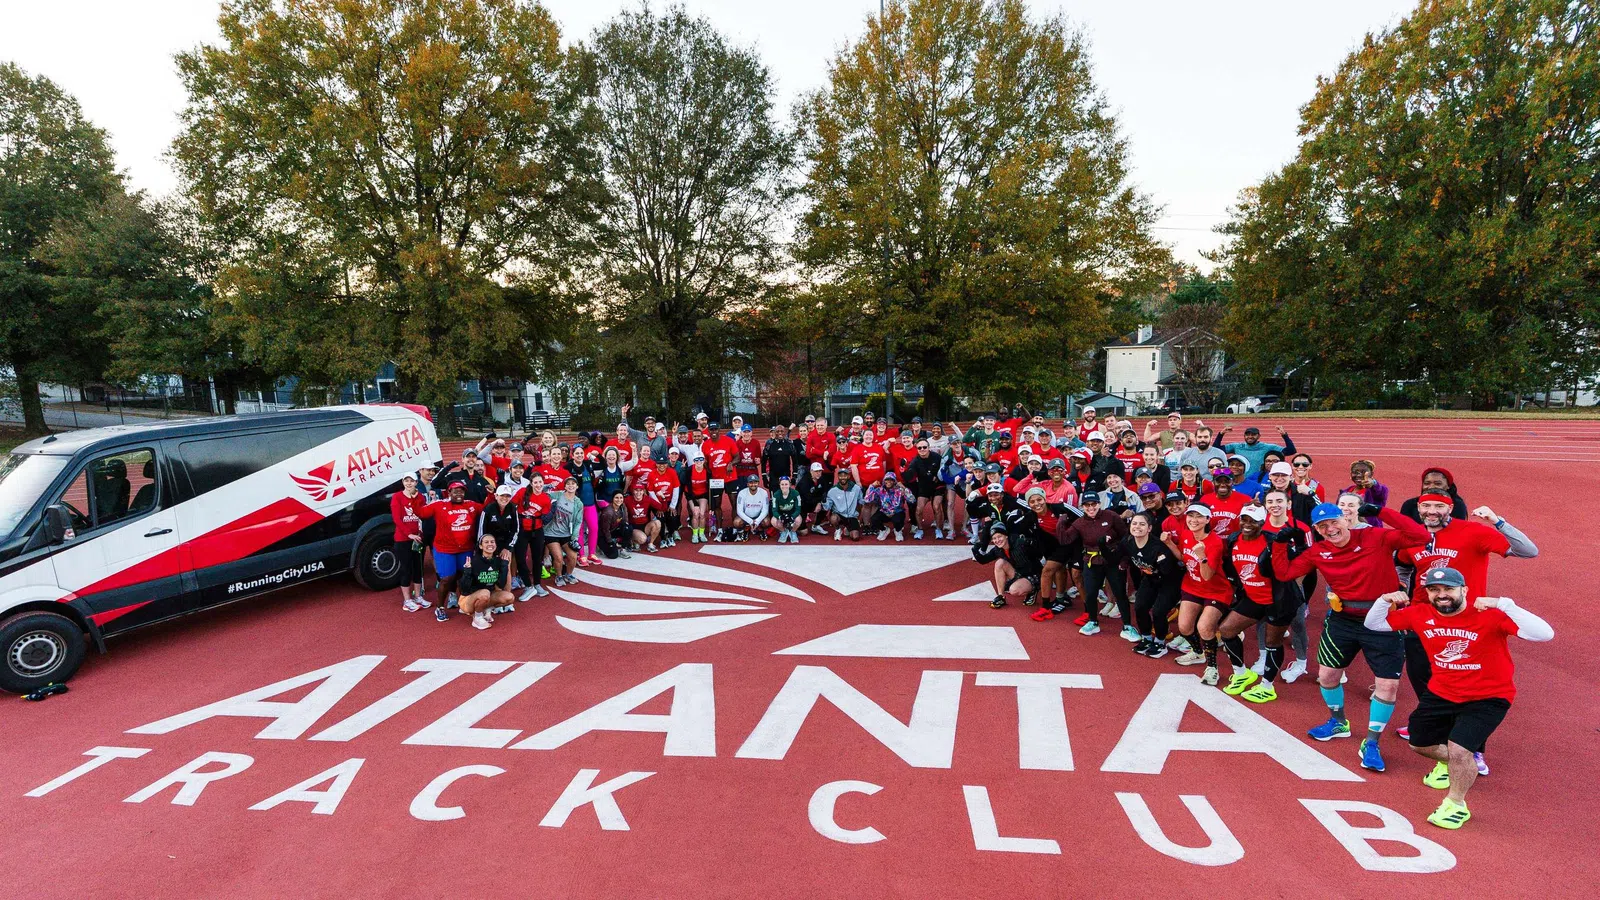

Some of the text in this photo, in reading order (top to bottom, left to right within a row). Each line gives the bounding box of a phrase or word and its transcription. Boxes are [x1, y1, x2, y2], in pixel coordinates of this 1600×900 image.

[347, 424, 425, 477] ATLANTA
[350, 443, 429, 487] TRACK CLUB
[227, 561, 325, 594] #RunningCityUSA
[1424, 628, 1478, 641] IN-TRAINING
[124, 655, 1364, 782] ATLANTA
[24, 746, 1457, 873] TRACK CLUB
